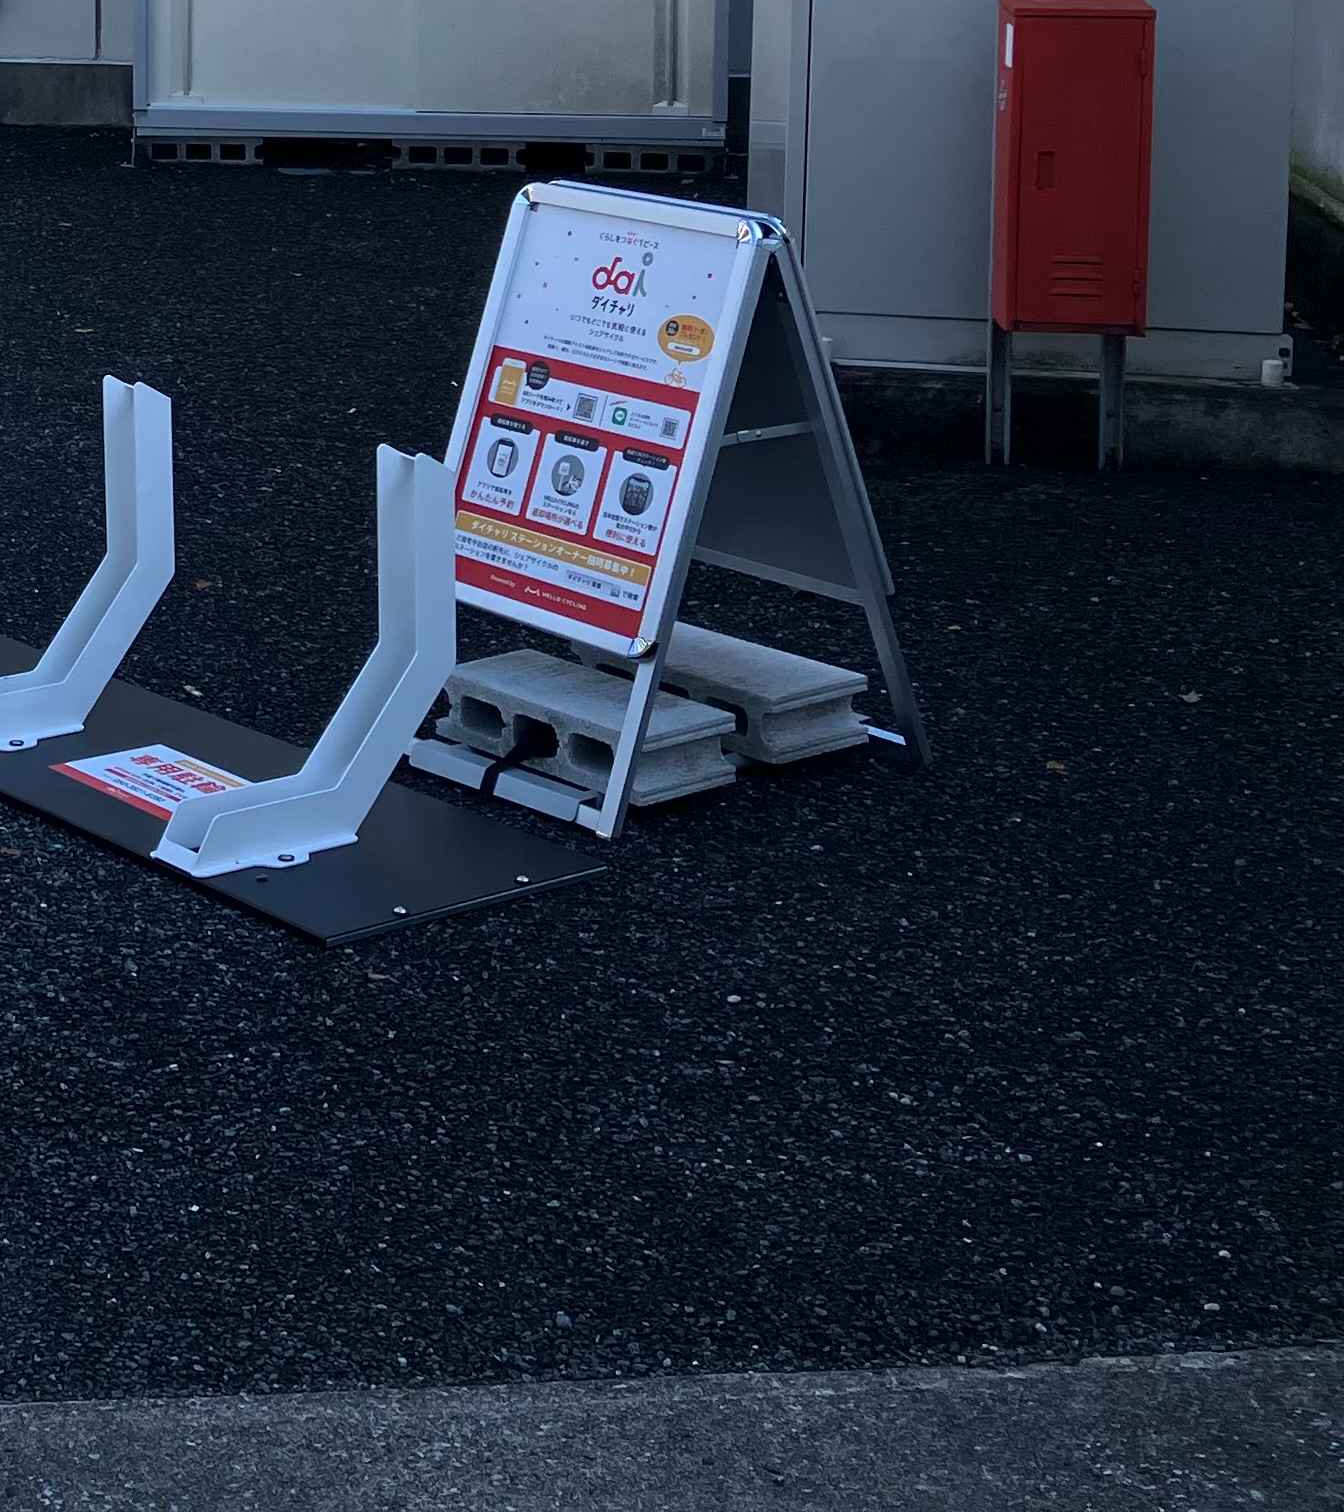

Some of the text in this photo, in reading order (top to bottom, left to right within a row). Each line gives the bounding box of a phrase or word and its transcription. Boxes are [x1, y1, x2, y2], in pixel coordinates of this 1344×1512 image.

[590, 294, 635, 318] ダイチャリ
